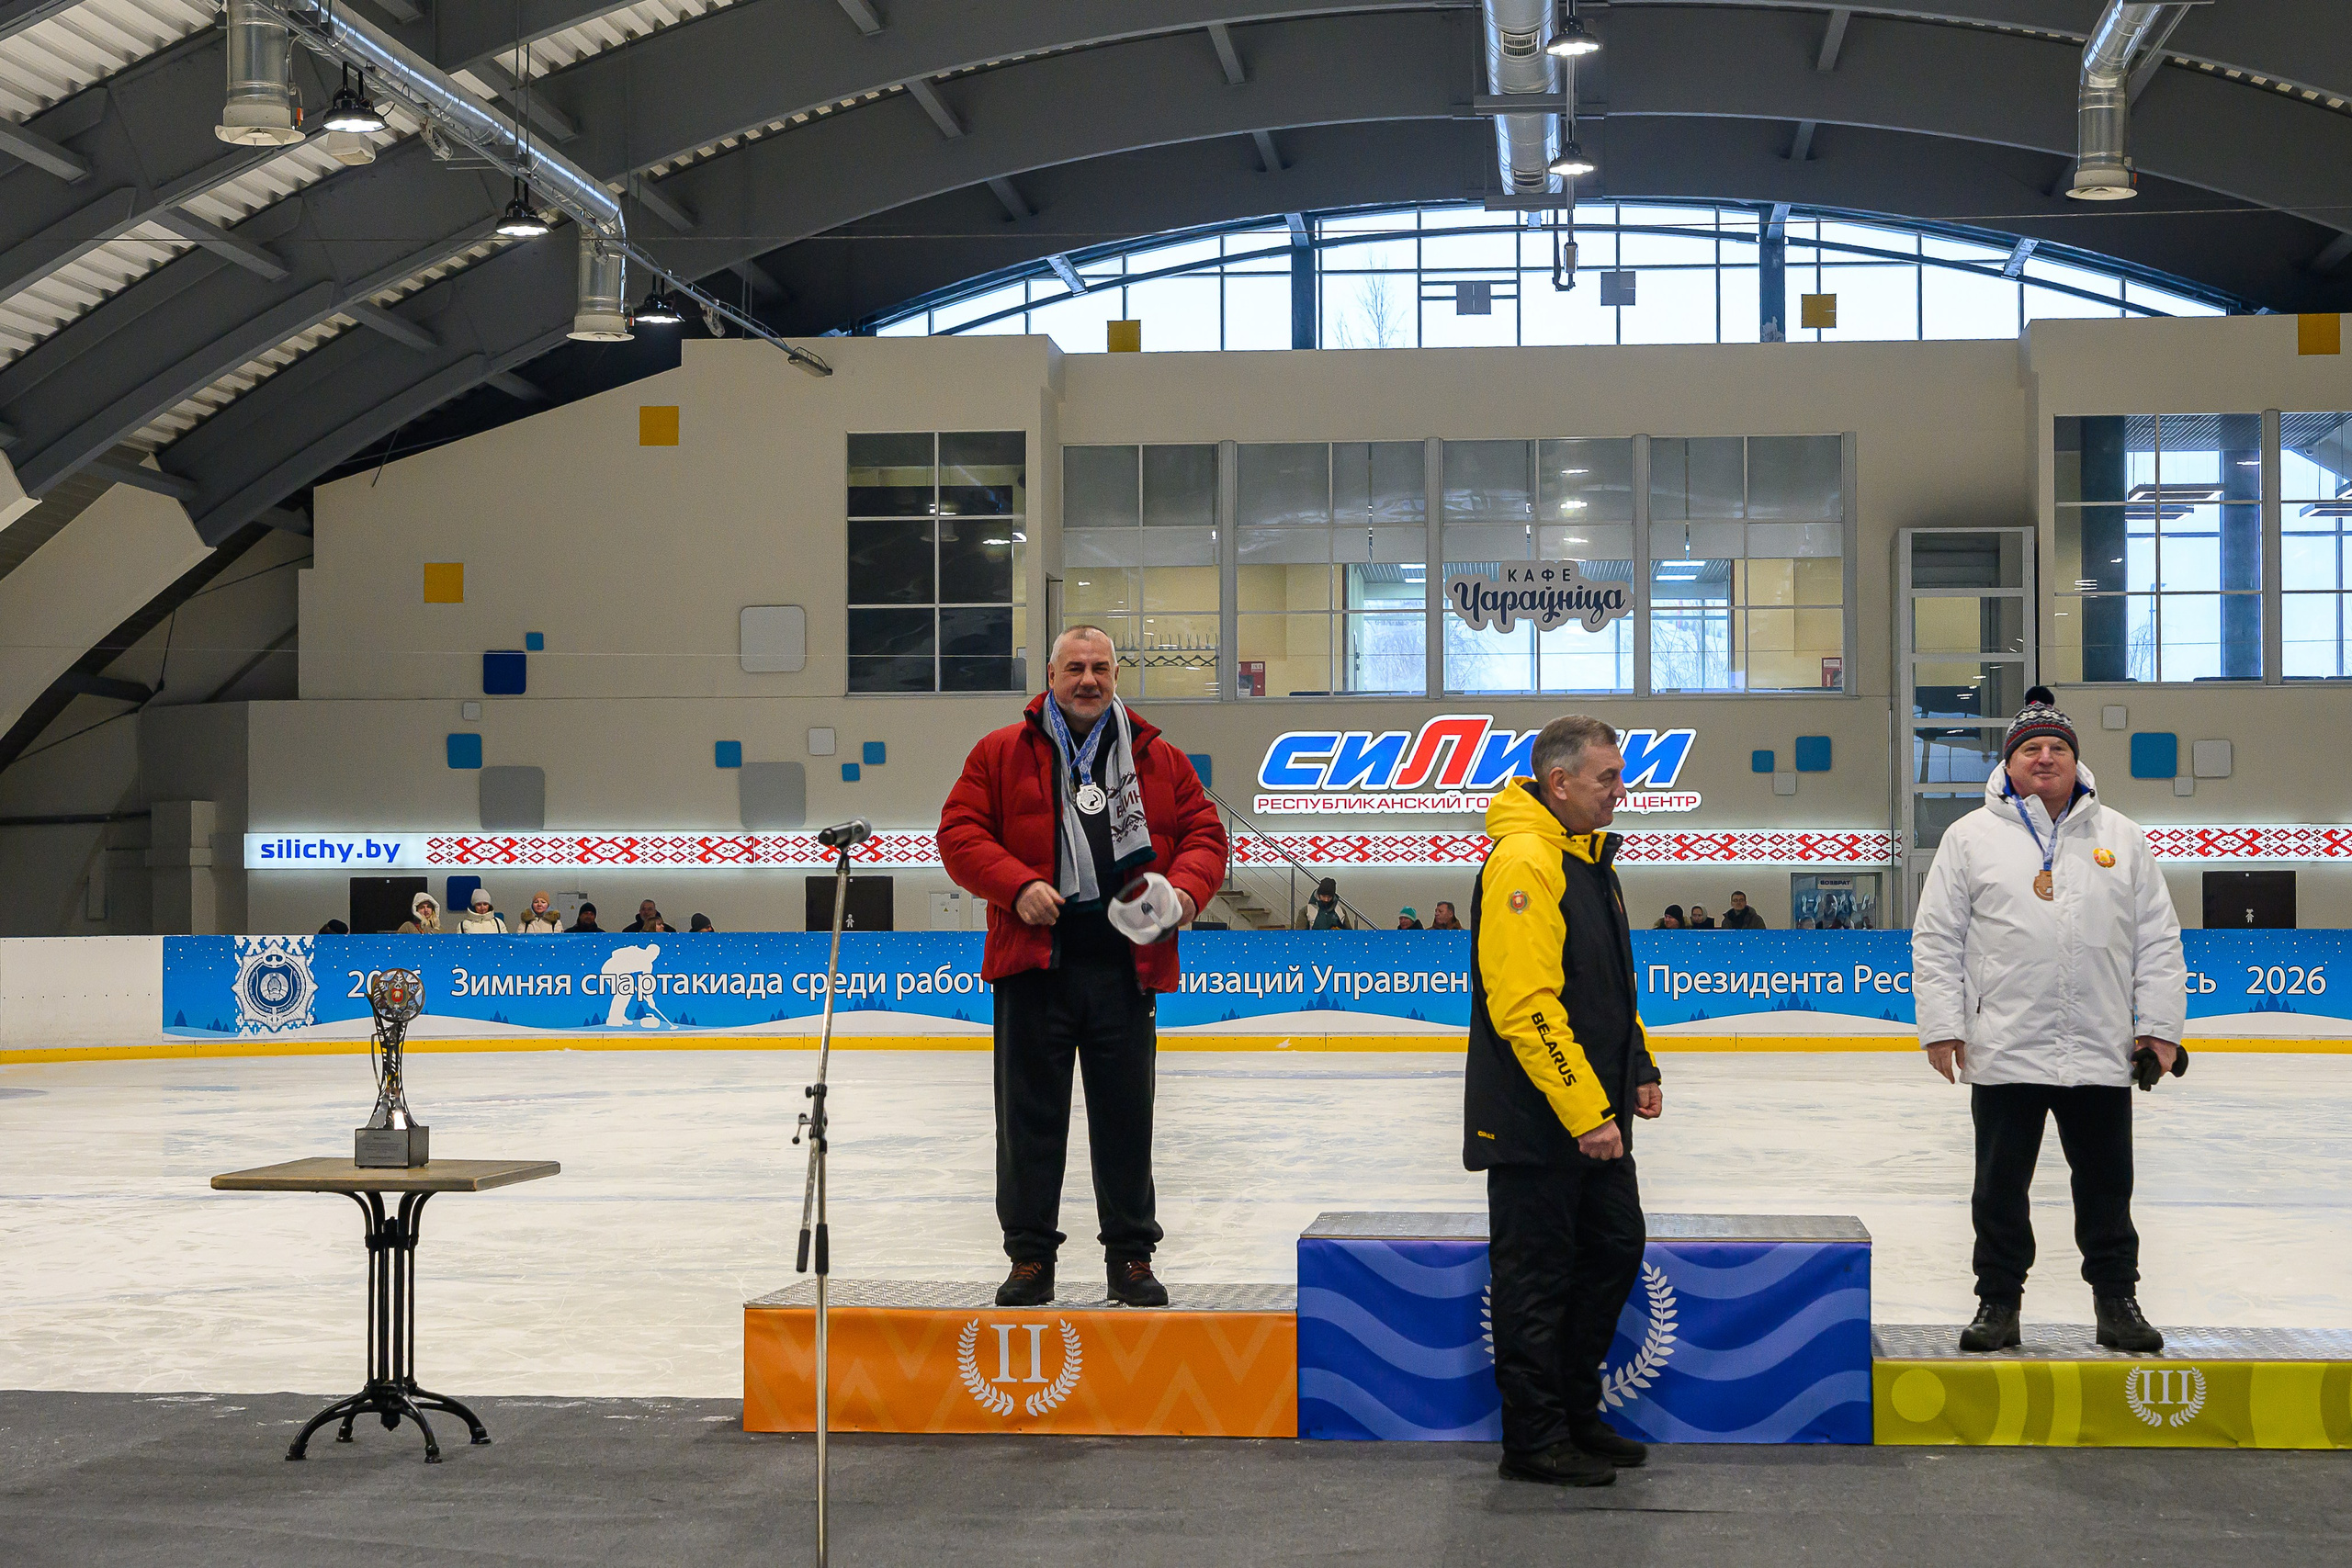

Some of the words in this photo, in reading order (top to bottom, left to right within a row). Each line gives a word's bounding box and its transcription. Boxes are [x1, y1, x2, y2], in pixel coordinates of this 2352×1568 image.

[1507, 568, 1571, 582] КАФЕ
[1453, 581, 1625, 625] Чараўніца
[1257, 795, 1461, 810] РЕСПУБЛИКАНСКИЙ
[1633, 795, 1698, 809] ЦЕНТР
[261, 839, 401, 863] silichy.by
[450, 967, 572, 997] Зимняя
[581, 972, 783, 1002] спартакиада
[792, 972, 887, 1001] среди
[895, 964, 994, 1001] работ
[1311, 964, 1473, 1000] Управлен
[1648, 964, 1844, 1000] Президента
[2245, 965, 2328, 995] 2026
[1531, 1011, 1577, 1088] BELARUS
